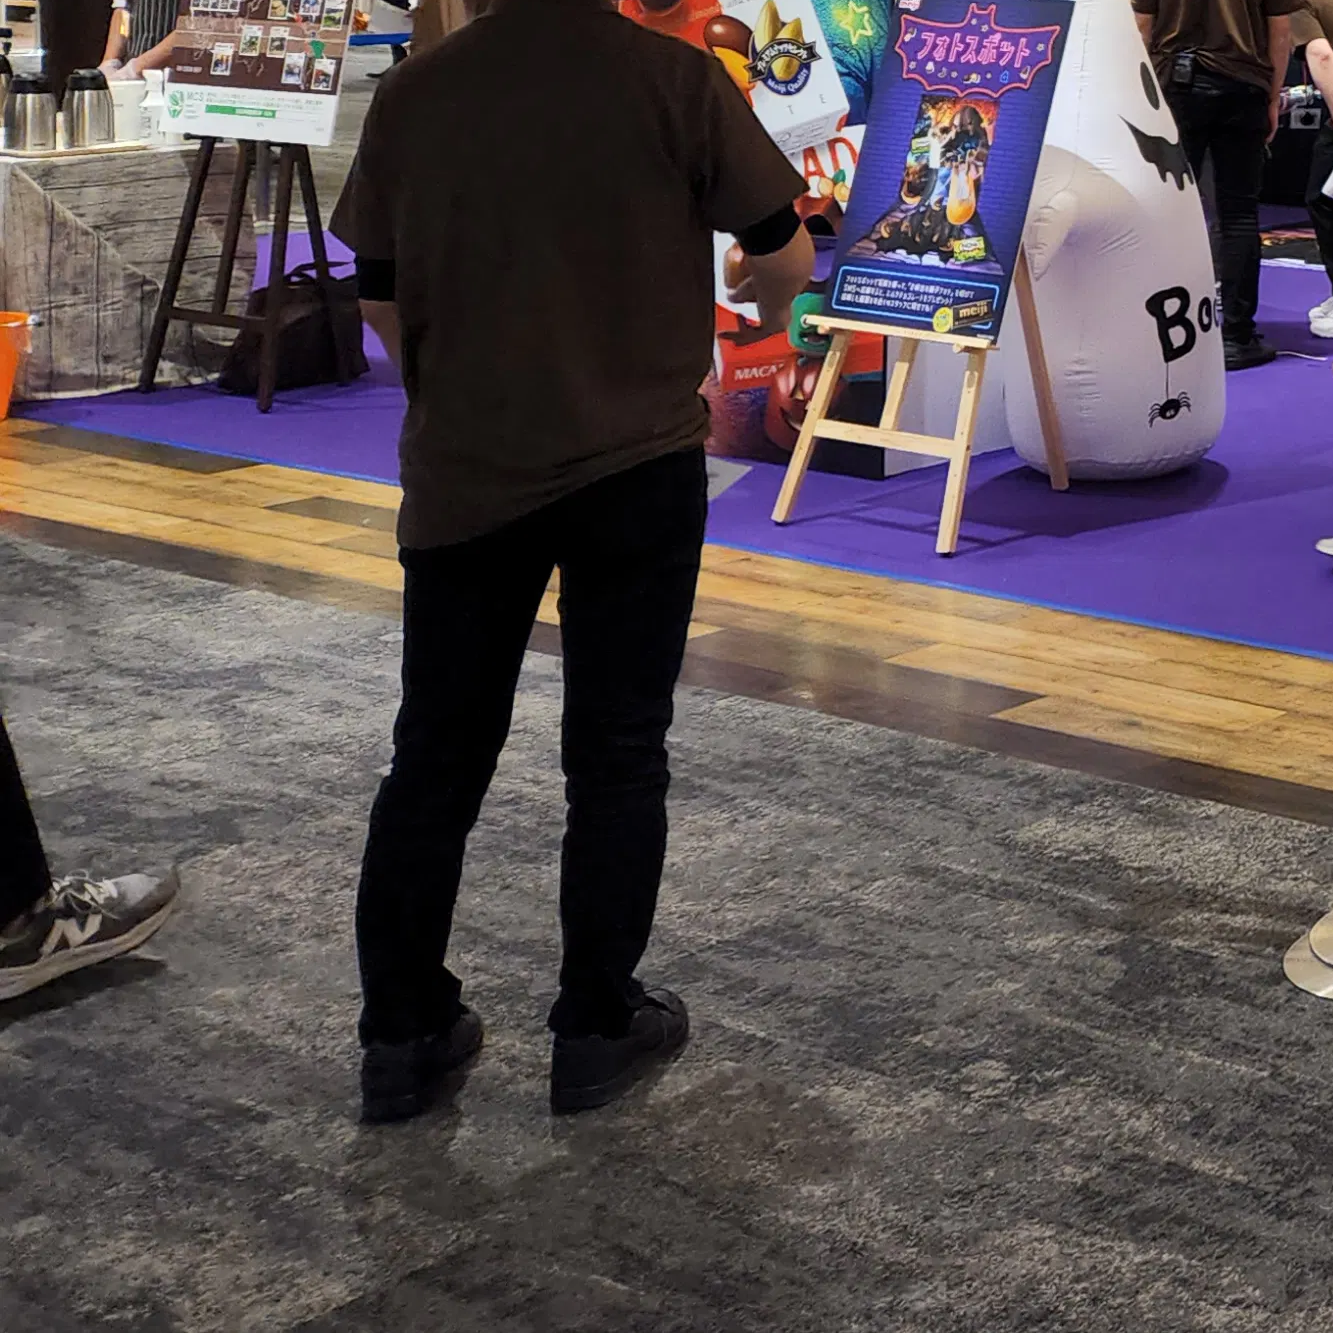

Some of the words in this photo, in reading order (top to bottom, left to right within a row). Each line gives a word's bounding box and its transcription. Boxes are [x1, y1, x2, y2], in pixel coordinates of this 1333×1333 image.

[917, 32, 1031, 68] フォトスポット
[959, 302, 989, 319] meiji
[735, 362, 785, 382] MACA
